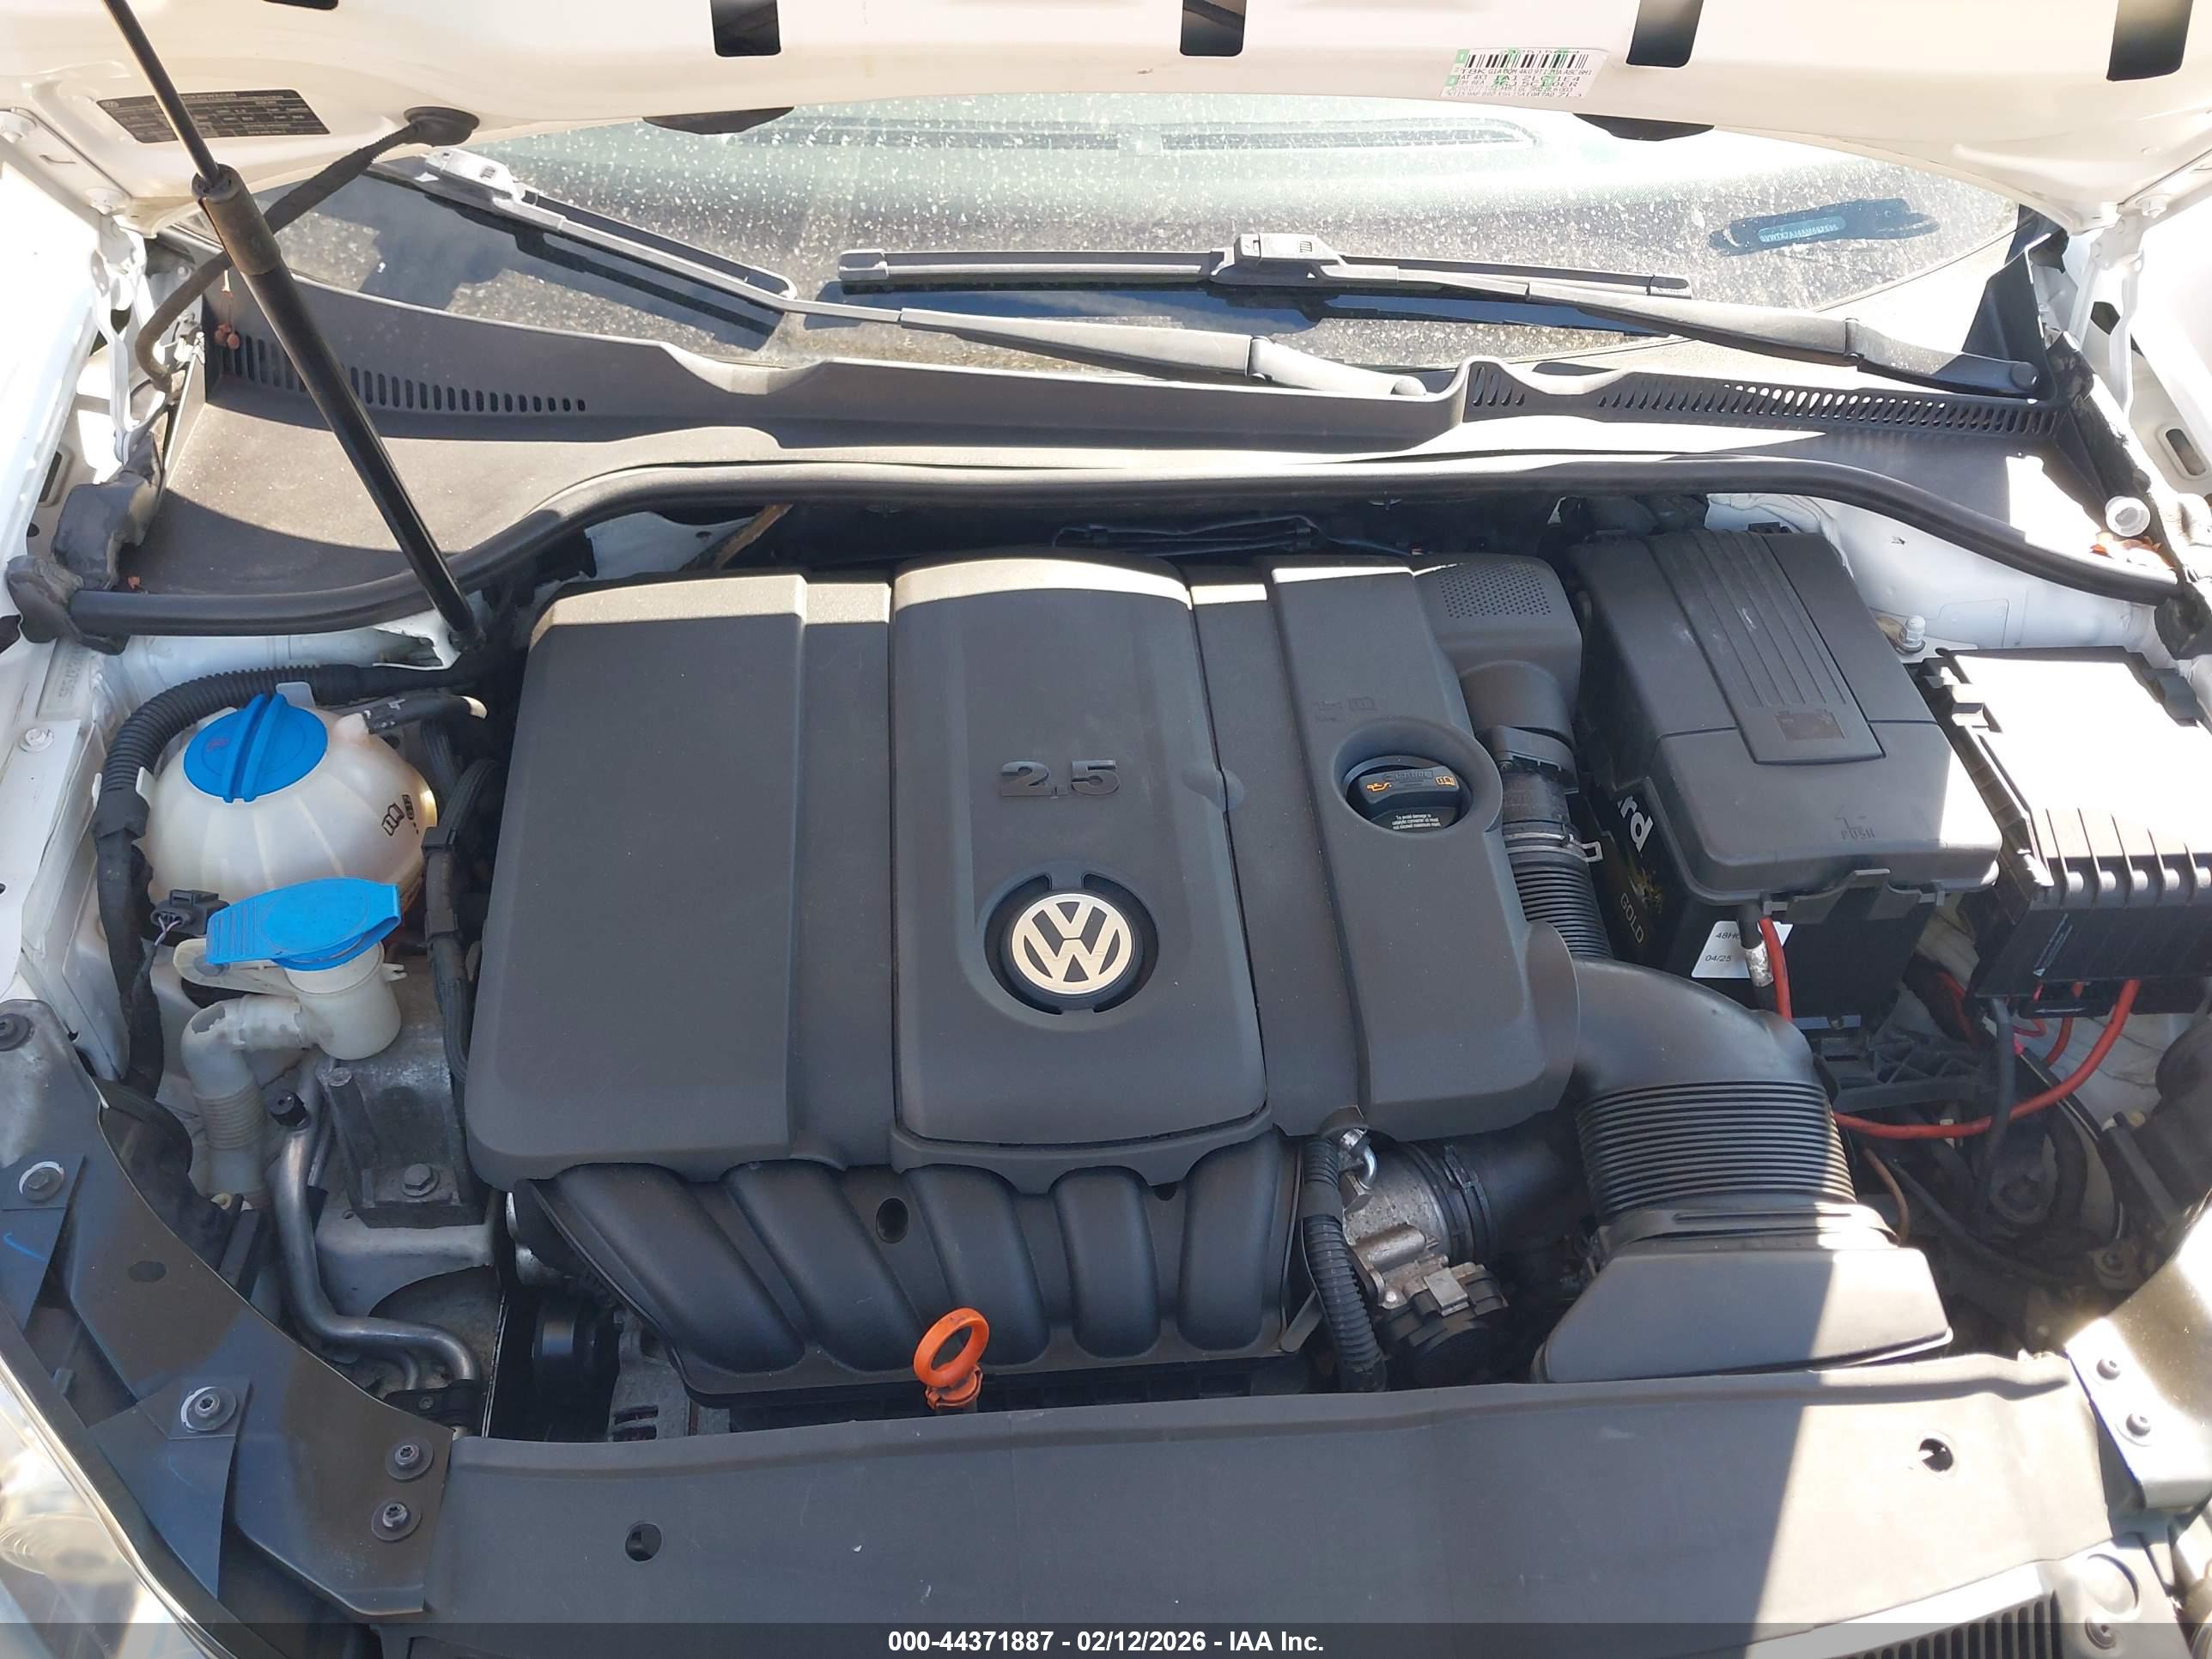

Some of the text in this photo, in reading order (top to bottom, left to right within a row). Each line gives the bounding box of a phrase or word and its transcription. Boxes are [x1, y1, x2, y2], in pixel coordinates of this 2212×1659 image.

[1000, 759, 1121, 799] 2.5
[1617, 795, 1654, 853] rd
[1620, 892, 1644, 944] GOLD
[1705, 954, 1732, 963] 04/25
